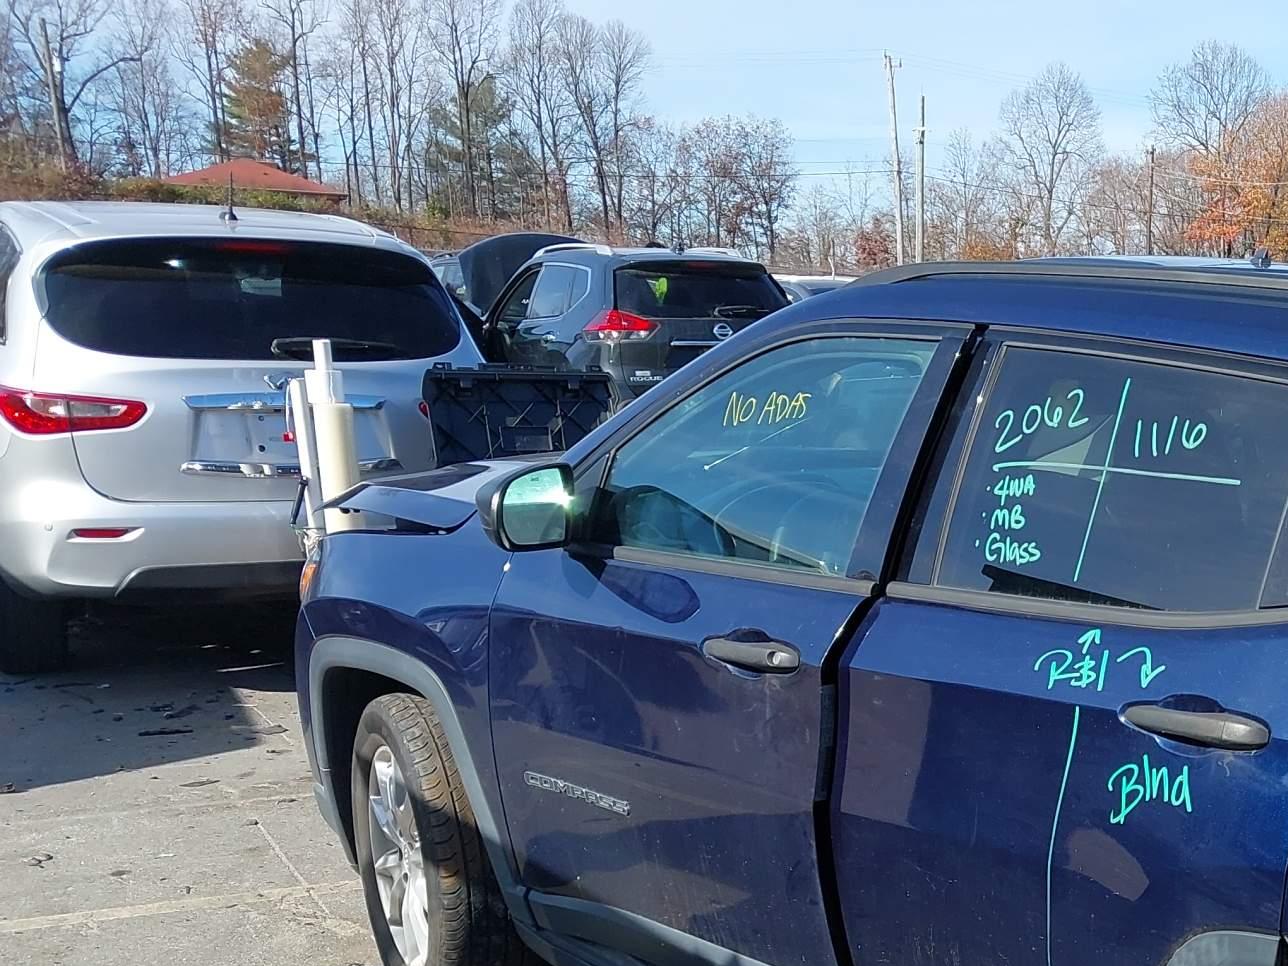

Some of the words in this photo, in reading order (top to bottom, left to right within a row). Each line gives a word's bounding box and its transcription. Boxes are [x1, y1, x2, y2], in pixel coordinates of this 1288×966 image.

[723, 391, 757, 427] NO
[757, 391, 812, 425] ADAS
[994, 388, 1090, 453] 2062
[990, 504, 1026, 530] MB
[984, 532, 1042, 565] Glass
[523, 770, 631, 817] COMPASS
